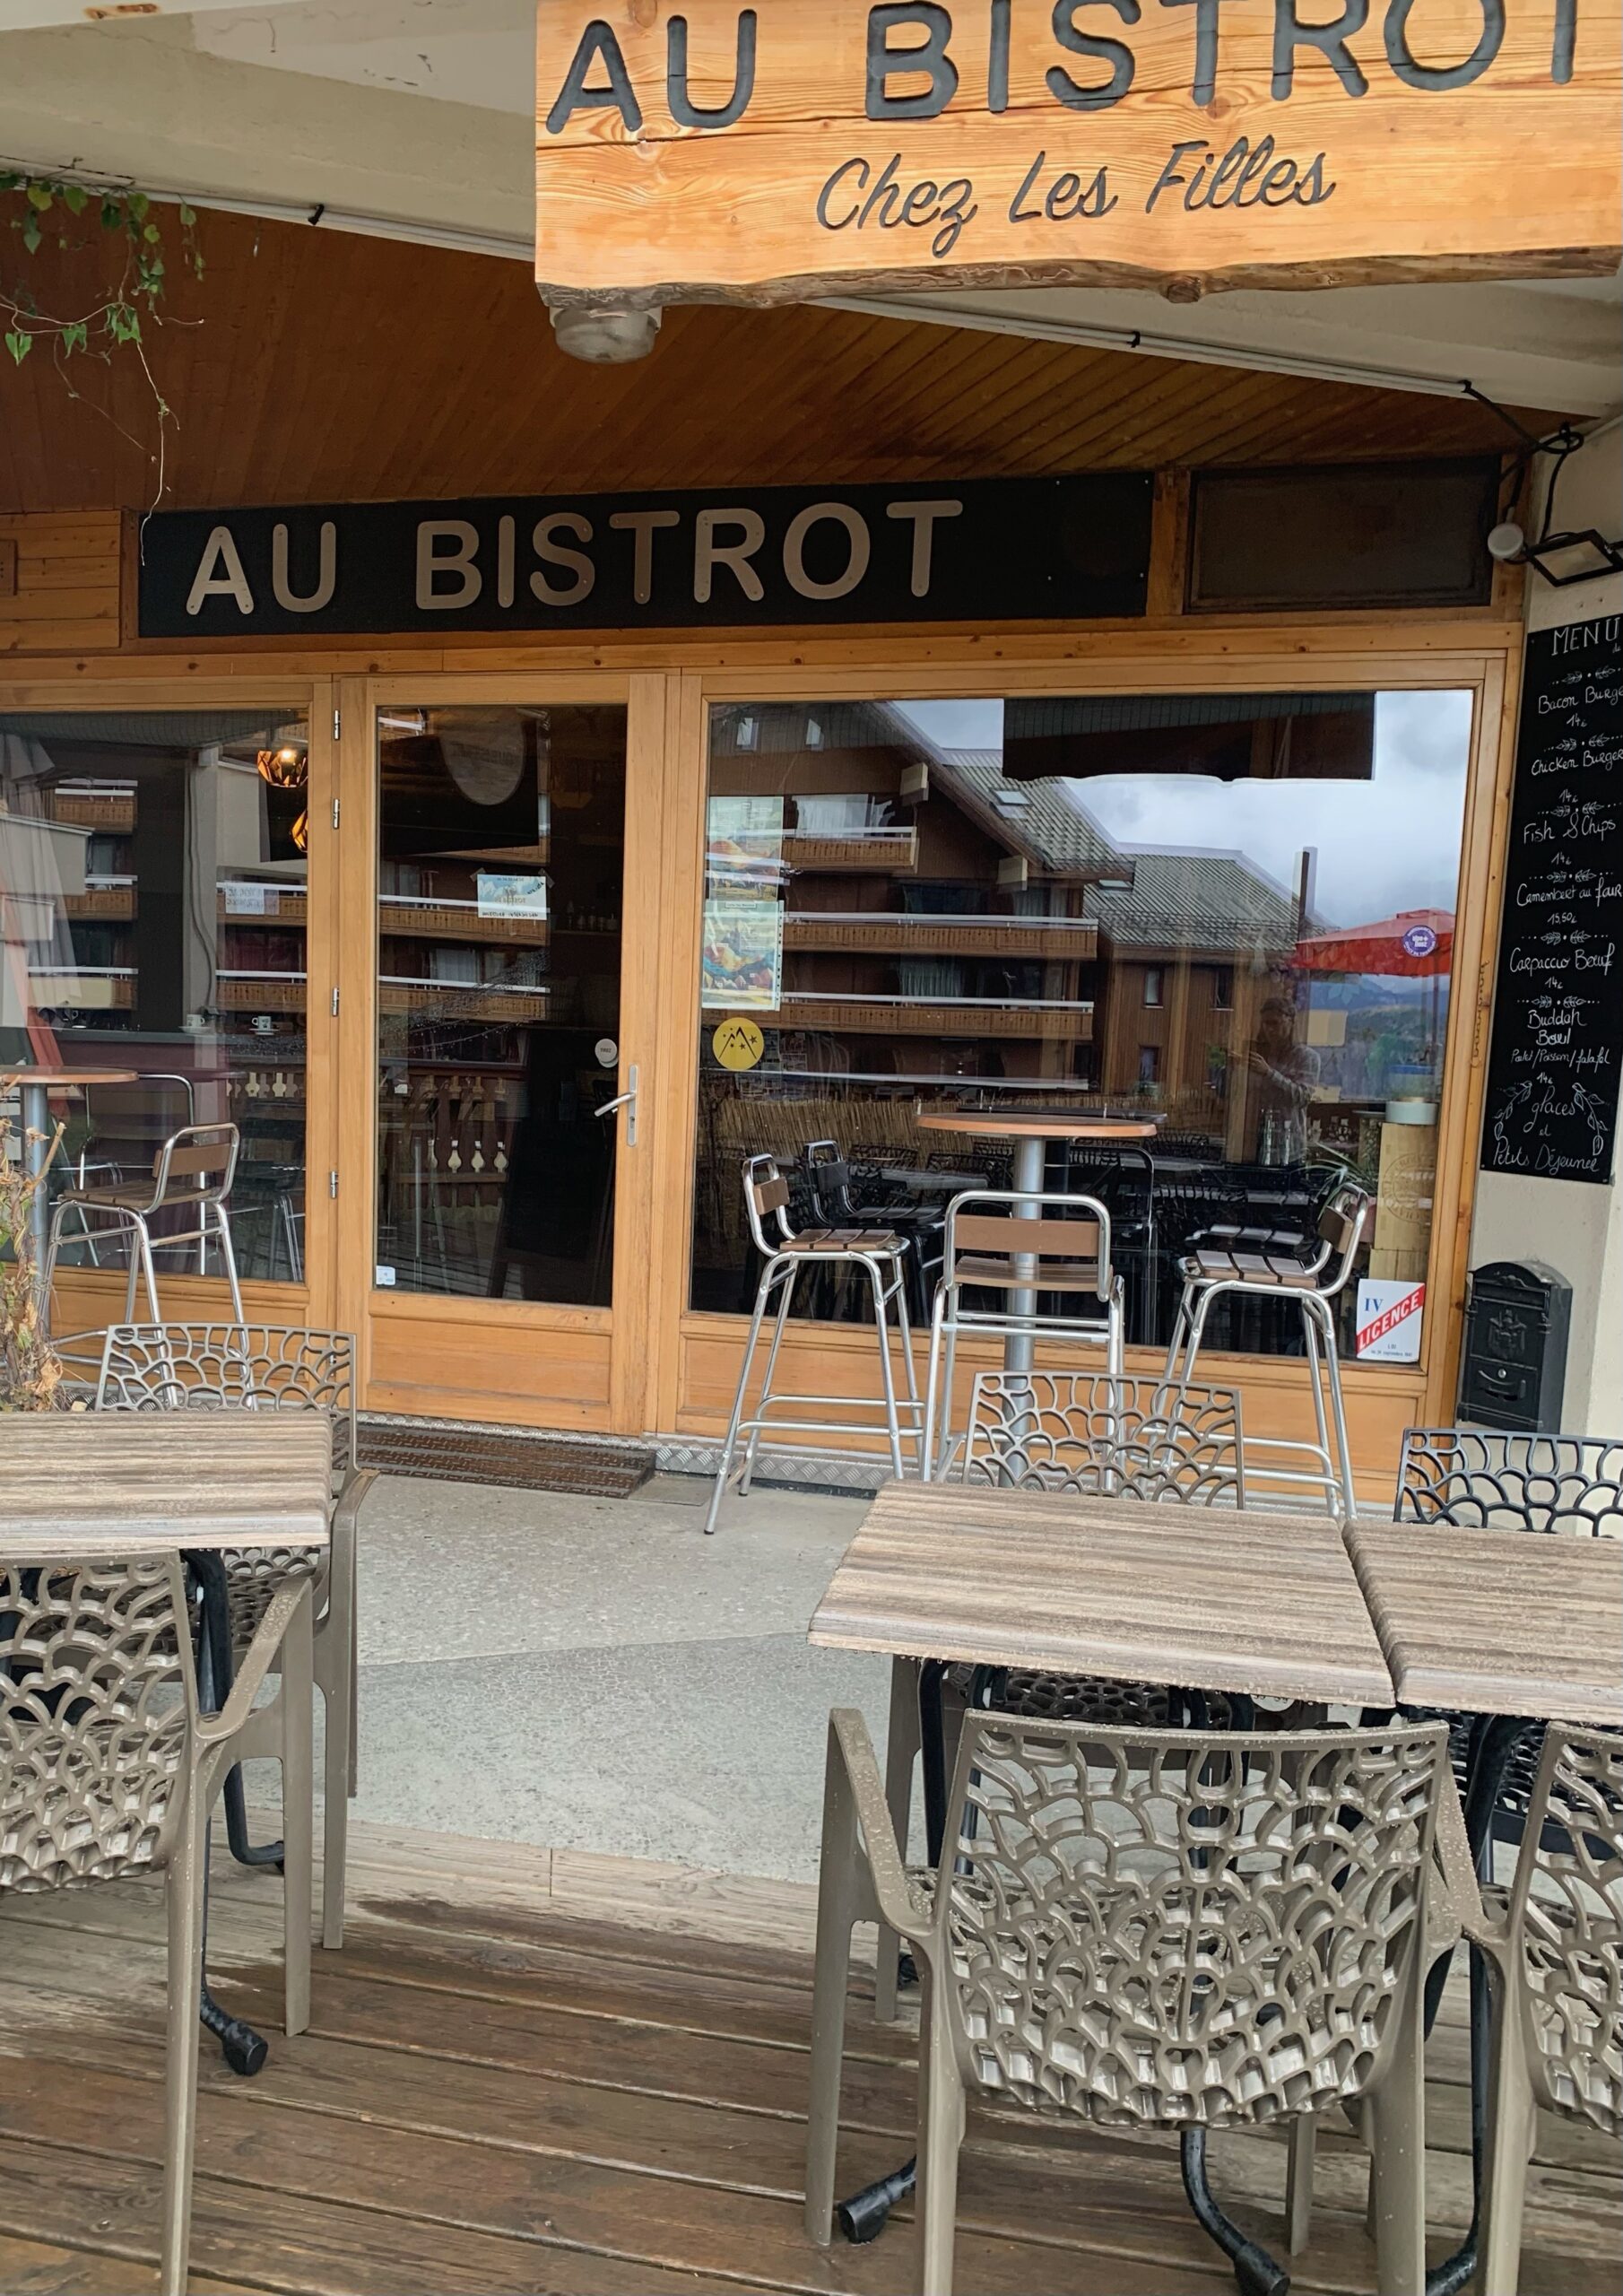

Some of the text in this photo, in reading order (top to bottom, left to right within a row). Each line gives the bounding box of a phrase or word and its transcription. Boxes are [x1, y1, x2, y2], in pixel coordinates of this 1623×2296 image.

[546, 9, 757, 134] AU
[816, 134, 1336, 258] Chez Les Filles
[186, 499, 964, 616] AU BISTROT
[1551, 617, 1620, 656] MENU
[1538, 686, 1623, 714] Bacon Burge
[1524, 820, 1556, 844] Fish
[1581, 814, 1616, 841] Chips
[1516, 883, 1576, 907] Camembert
[1579, 889, 1592, 899] au
[1510, 947, 1570, 977] Carpaccio
[1364, 1297, 1384, 1312] IV
[1358, 1292, 1419, 1352] LICENCE
